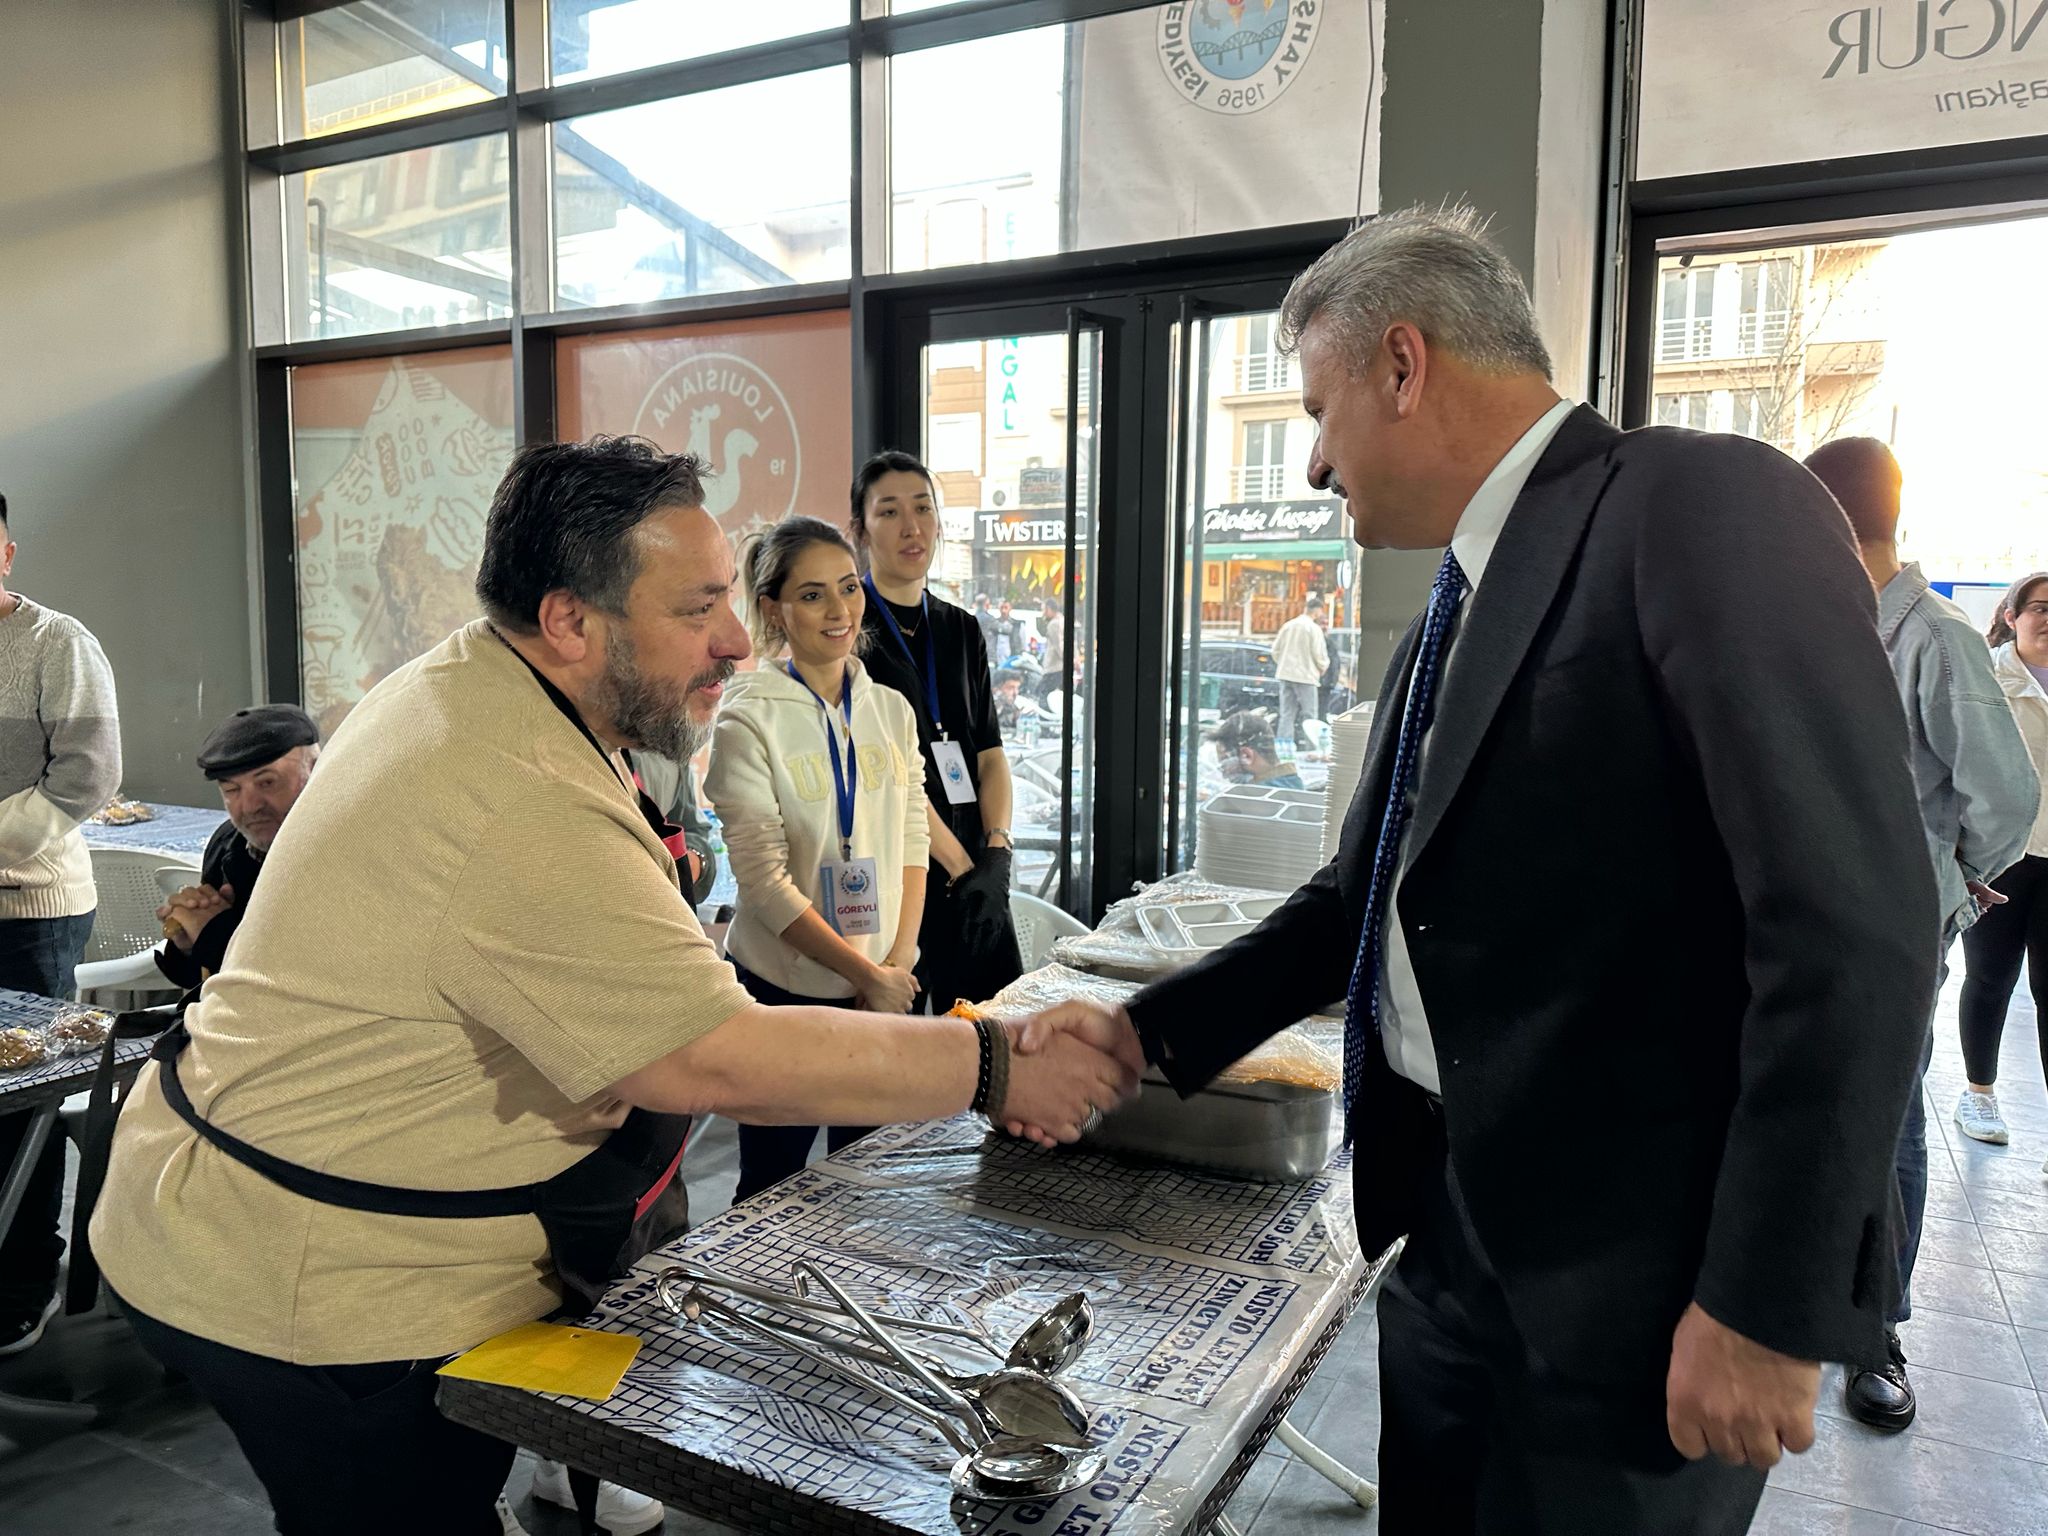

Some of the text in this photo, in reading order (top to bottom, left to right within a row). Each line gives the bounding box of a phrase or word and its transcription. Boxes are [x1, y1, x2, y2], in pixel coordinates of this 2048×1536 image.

[979, 514, 1066, 543] TWISTER
[837, 903, 877, 915] GÖREVLİ
[1274, 1179, 1332, 1235] GELDİNİZ
[1171, 1277, 1250, 1351] GELDİNİZ
[1228, 1284, 1284, 1336] OLSUN
[1090, 1423, 1168, 1502] OLSUN
